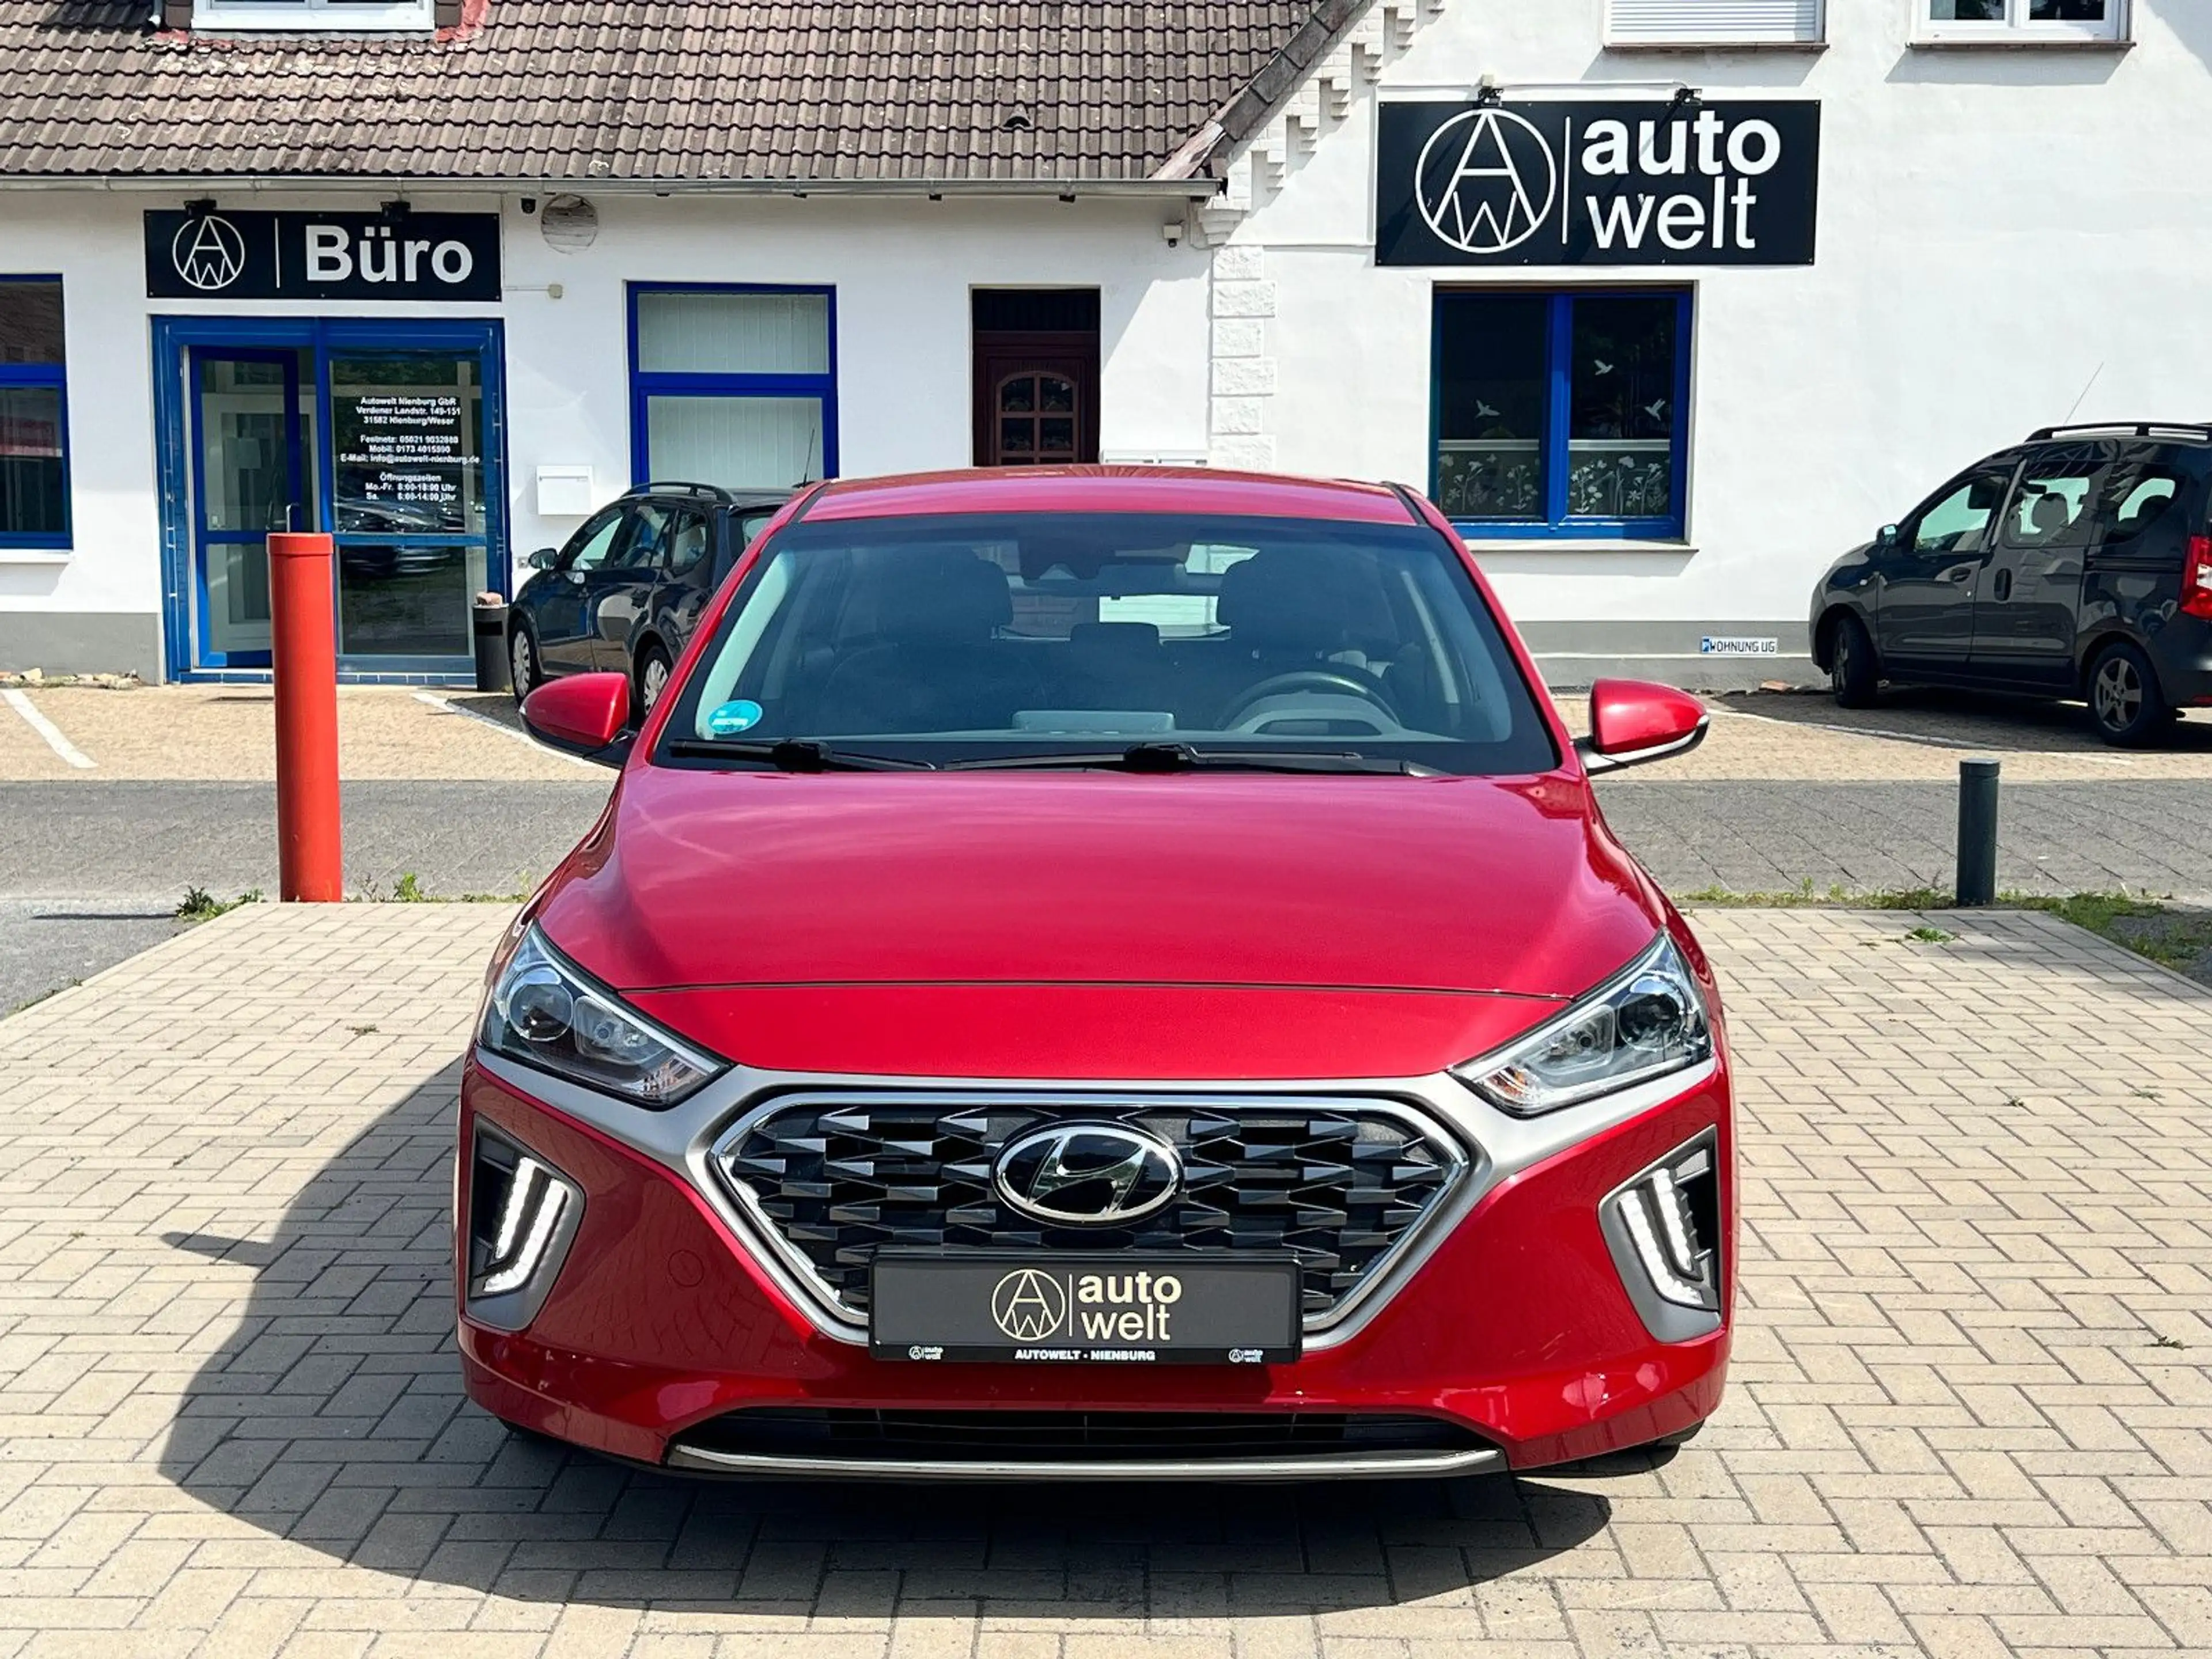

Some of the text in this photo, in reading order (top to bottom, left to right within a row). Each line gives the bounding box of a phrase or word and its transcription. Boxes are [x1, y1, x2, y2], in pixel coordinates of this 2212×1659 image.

[1581, 109, 1781, 176] auto
[1585, 176, 1757, 250] welt
[306, 225, 473, 283] Büro
[361, 397, 397, 406] Autowelt
[398, 397, 436, 407] Nienburg
[1077, 1270, 1182, 1304] auto
[1080, 1304, 1171, 1341] welt
[1014, 1349, 1156, 1361] AUTOWELT NIENBURG
